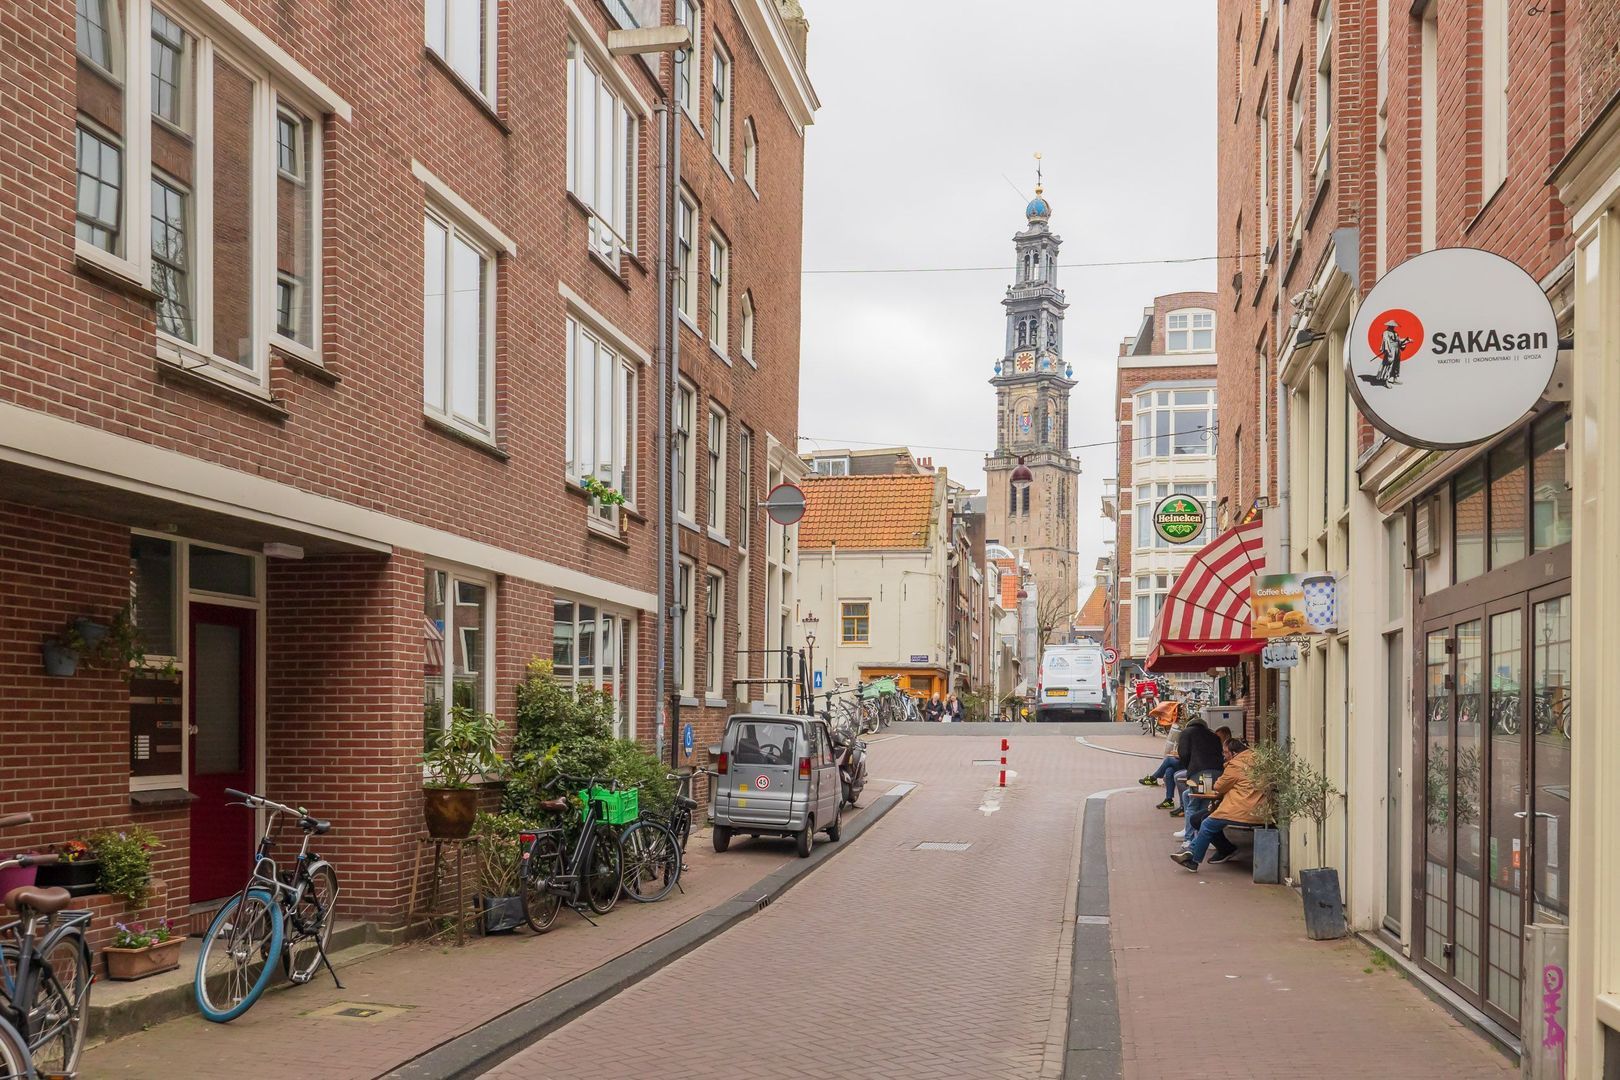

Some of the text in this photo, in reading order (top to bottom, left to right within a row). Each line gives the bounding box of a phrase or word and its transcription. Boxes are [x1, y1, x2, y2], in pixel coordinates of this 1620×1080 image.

[1431, 329, 1548, 354] SAKAsan
[1158, 514, 1201, 522] Heineken
[1257, 588, 1280, 597] Coffee
[1263, 649, 1298, 665] Hind
